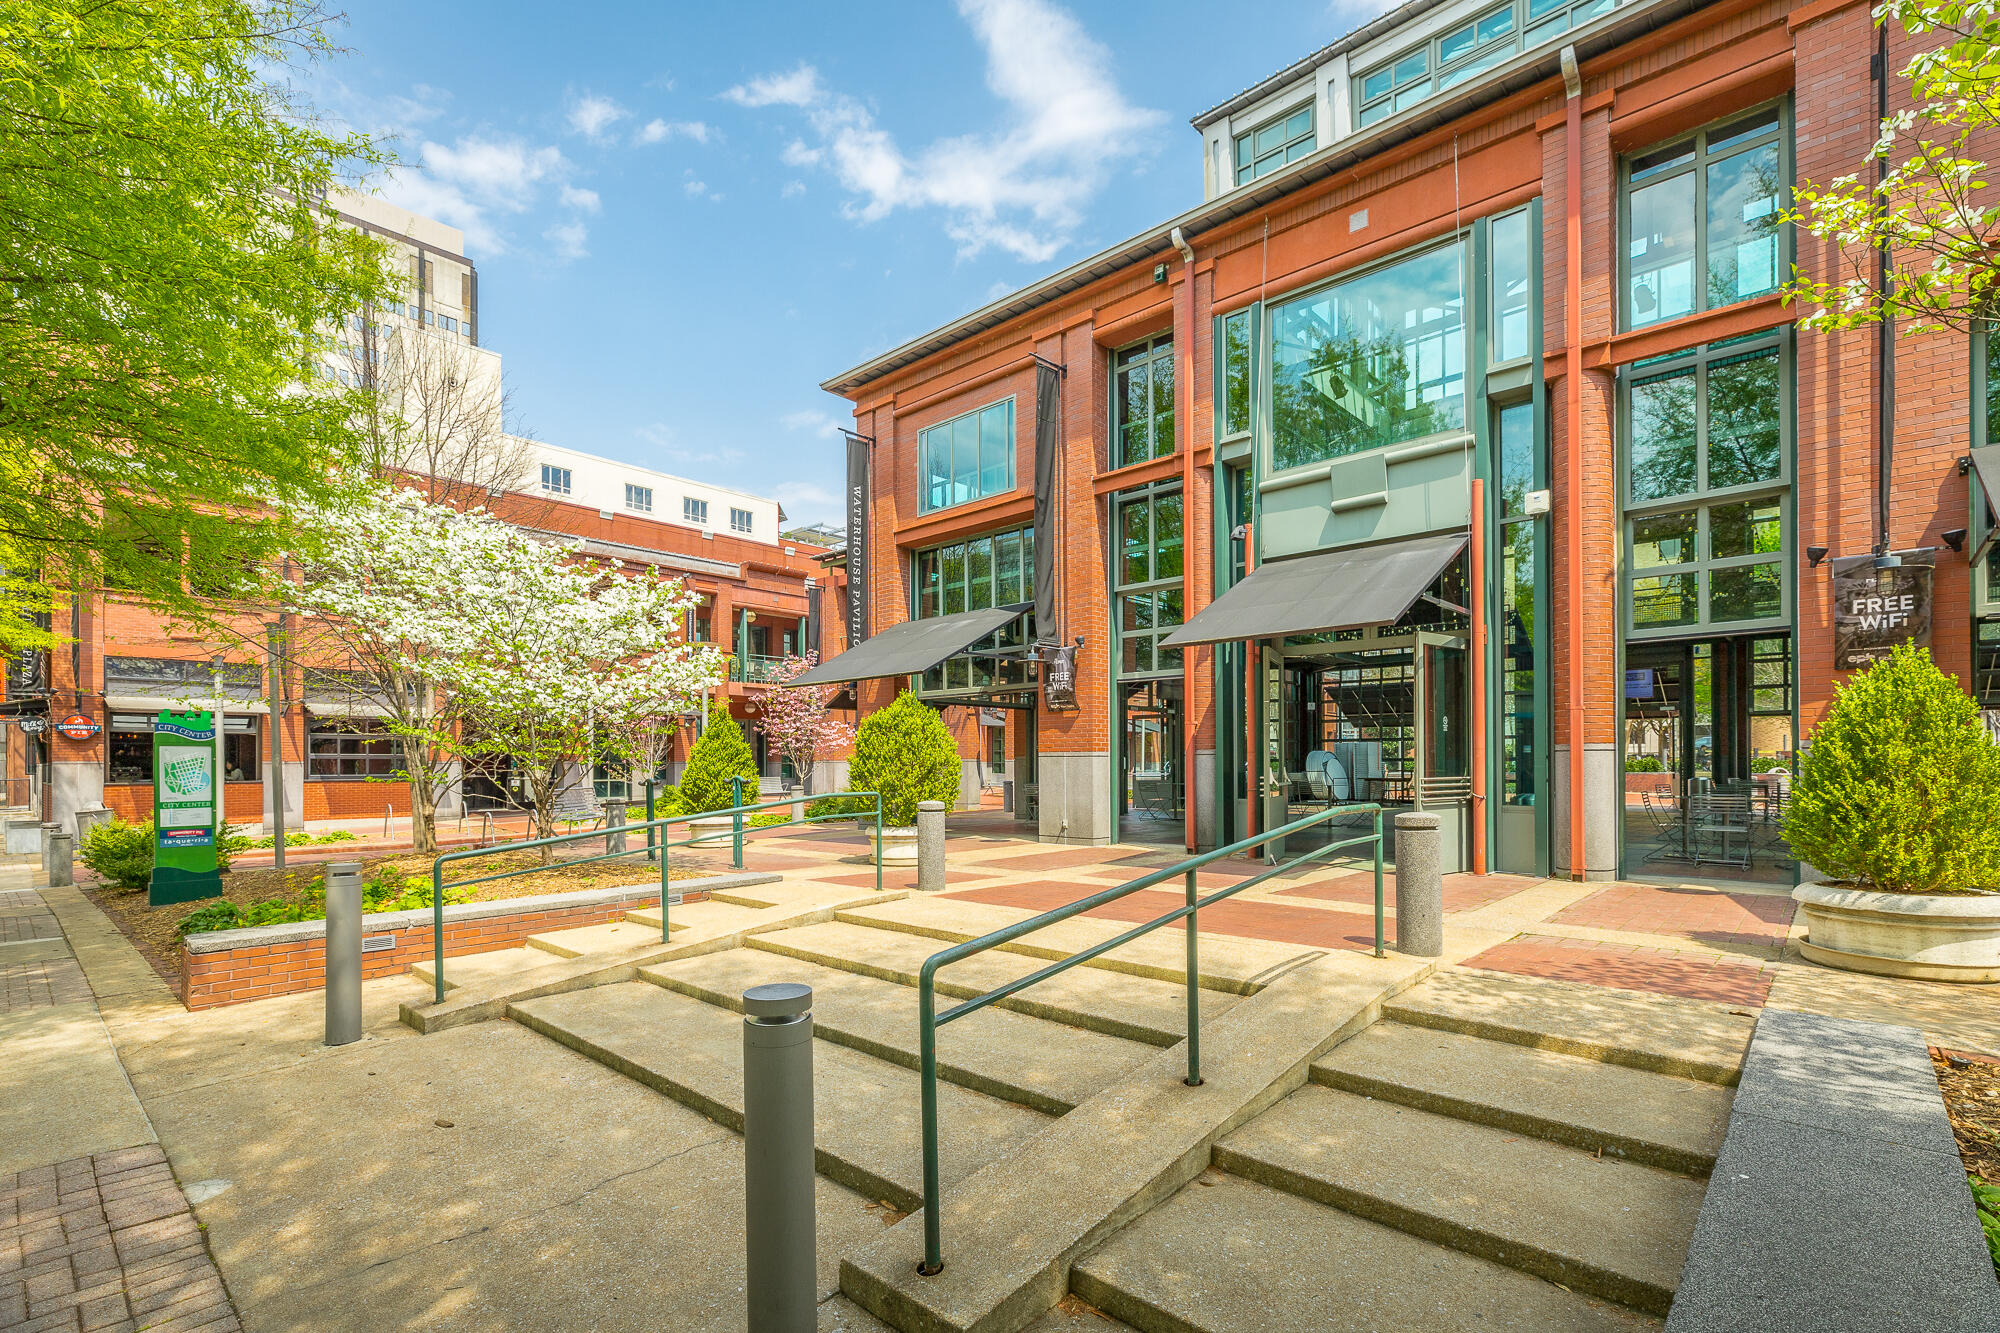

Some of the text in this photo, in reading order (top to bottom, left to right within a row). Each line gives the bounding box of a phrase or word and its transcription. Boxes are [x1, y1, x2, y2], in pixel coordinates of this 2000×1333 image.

[853, 485, 862, 585] WATERHOUSE
[1852, 594, 1915, 615] FREE
[1858, 612, 1909, 631] WiFi
[22, 650, 33, 686] PLAZA
[1049, 671, 1071, 682] FREE
[158, 724, 213, 738] CITY CENTER
